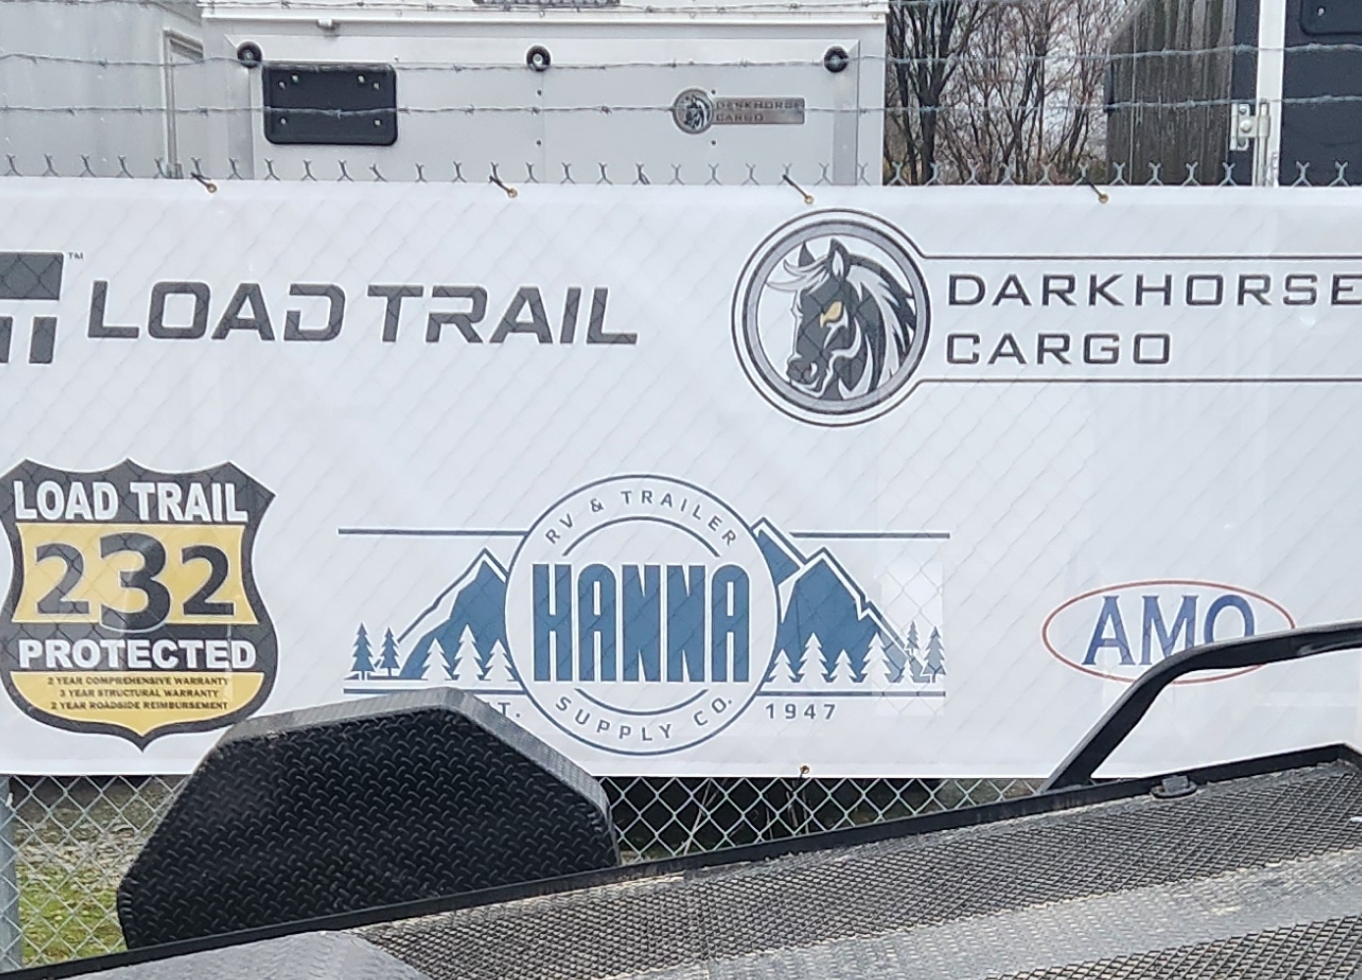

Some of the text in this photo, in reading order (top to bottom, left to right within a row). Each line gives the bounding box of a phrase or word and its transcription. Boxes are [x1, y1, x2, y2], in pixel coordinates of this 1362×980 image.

[716, 114, 764, 122] CARGO
[87, 280, 638, 344] LOAD TRAIL
[946, 332, 1171, 366] CARGO
[13, 480, 249, 523] LOAD TRAIL
[544, 490, 737, 546] RV & TRAILER
[35, 532, 235, 633] 232
[532, 563, 751, 683] HANNA
[18, 639, 257, 669] PROTECTED
[57, 677, 84, 685] YEAR
[86, 677, 172, 686] COMPREHENSIVE
[174, 677, 229, 686] WARRANTY
[68, 689, 95, 697] YEAR
[97, 689, 161, 698] STRUCTURAL
[163, 689, 219, 698] WARRANTY
[59, 701, 86, 710] YEAR
[89, 701, 140, 710] ROADSIDE
[143, 701, 229, 710] REIMBURSEMENT
[555, 696, 732, 742] SUPPLY CO.
[765, 703, 836, 720] 1947
